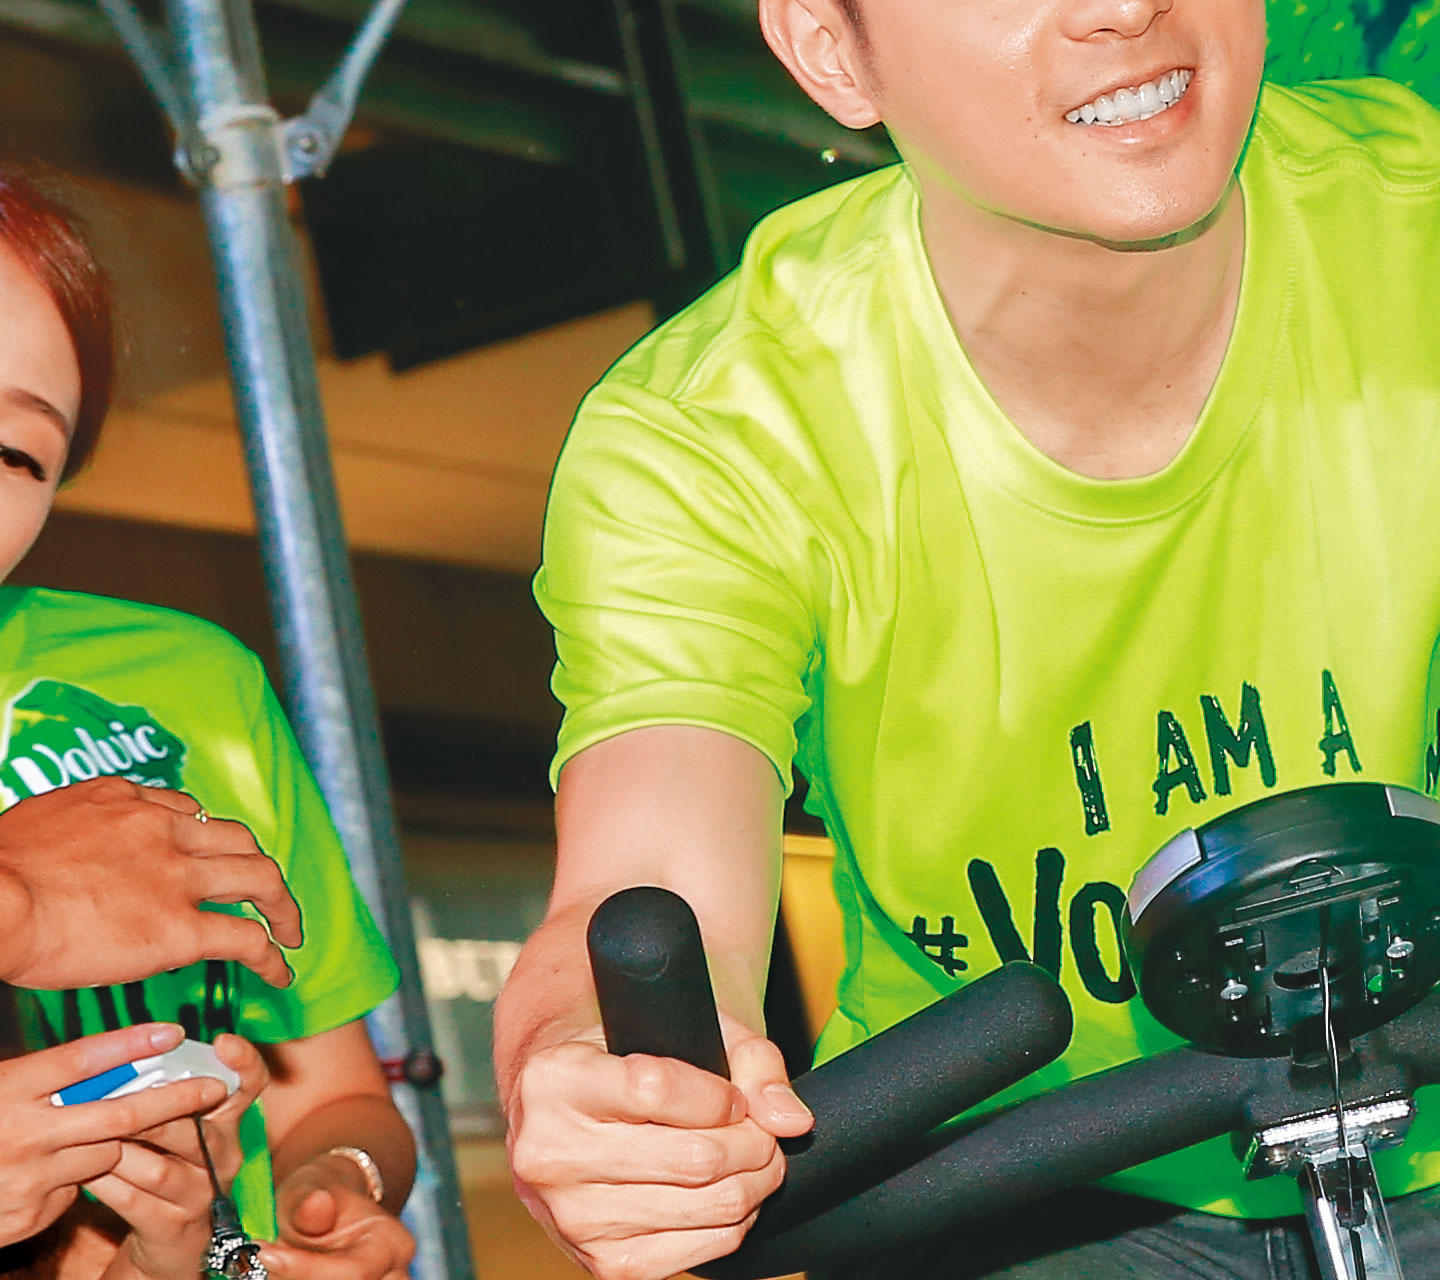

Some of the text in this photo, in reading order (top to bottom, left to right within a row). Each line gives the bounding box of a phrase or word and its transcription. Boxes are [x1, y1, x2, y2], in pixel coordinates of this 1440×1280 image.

[9, 721, 169, 797] Volvic
[1069, 721, 1110, 836] I
[1154, 681, 1277, 817] AM
[1319, 669, 1362, 776] A
